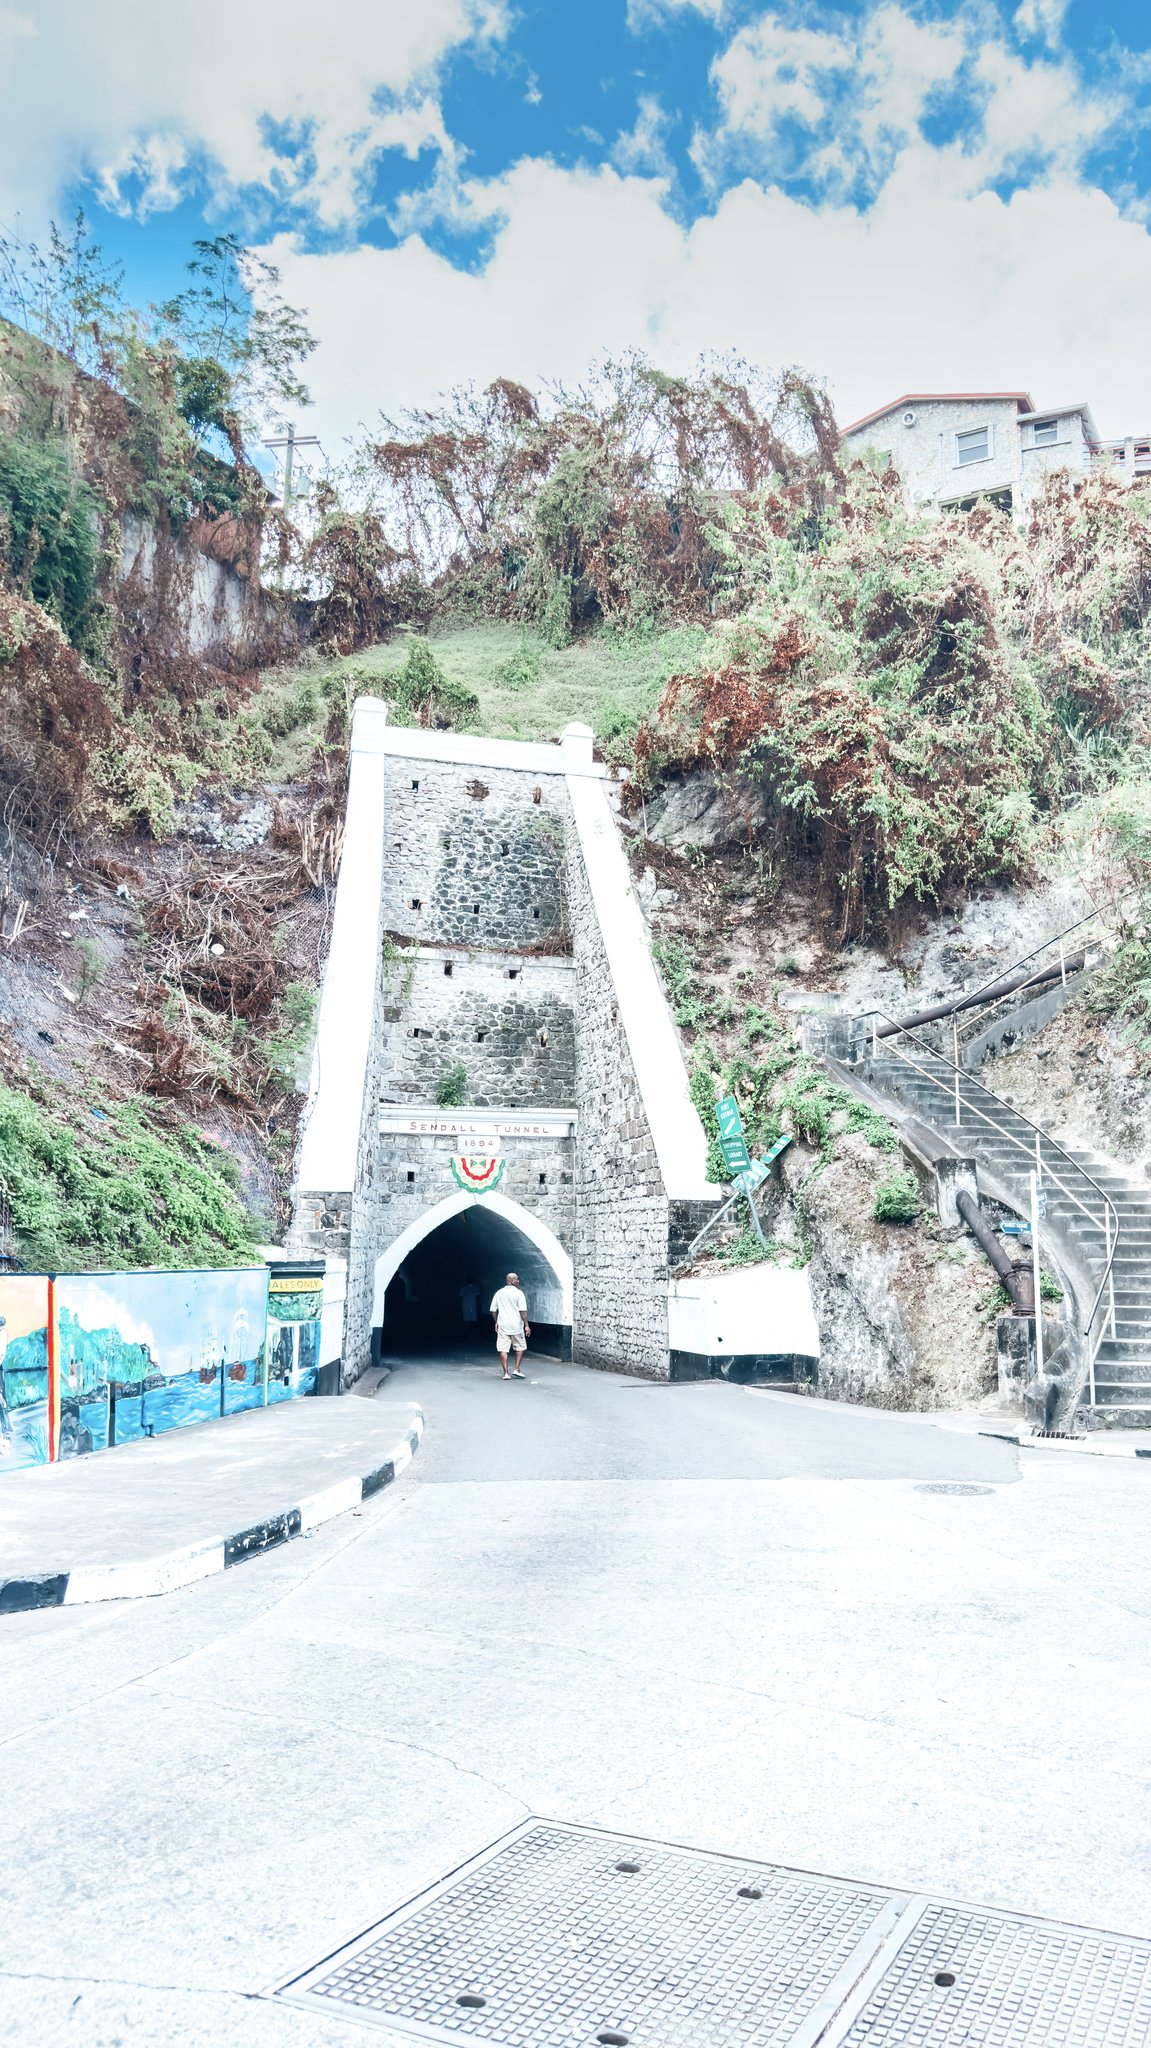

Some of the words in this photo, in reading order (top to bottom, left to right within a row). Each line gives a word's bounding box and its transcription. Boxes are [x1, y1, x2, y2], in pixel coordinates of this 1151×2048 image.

[410, 1121, 476, 1131] SENDALL
[494, 1124, 549, 1133] TUNNEL
[464, 1139, 494, 1147] 1894
[270, 1281, 295, 1289] ALES
[297, 1280, 319, 1288] ONLY
